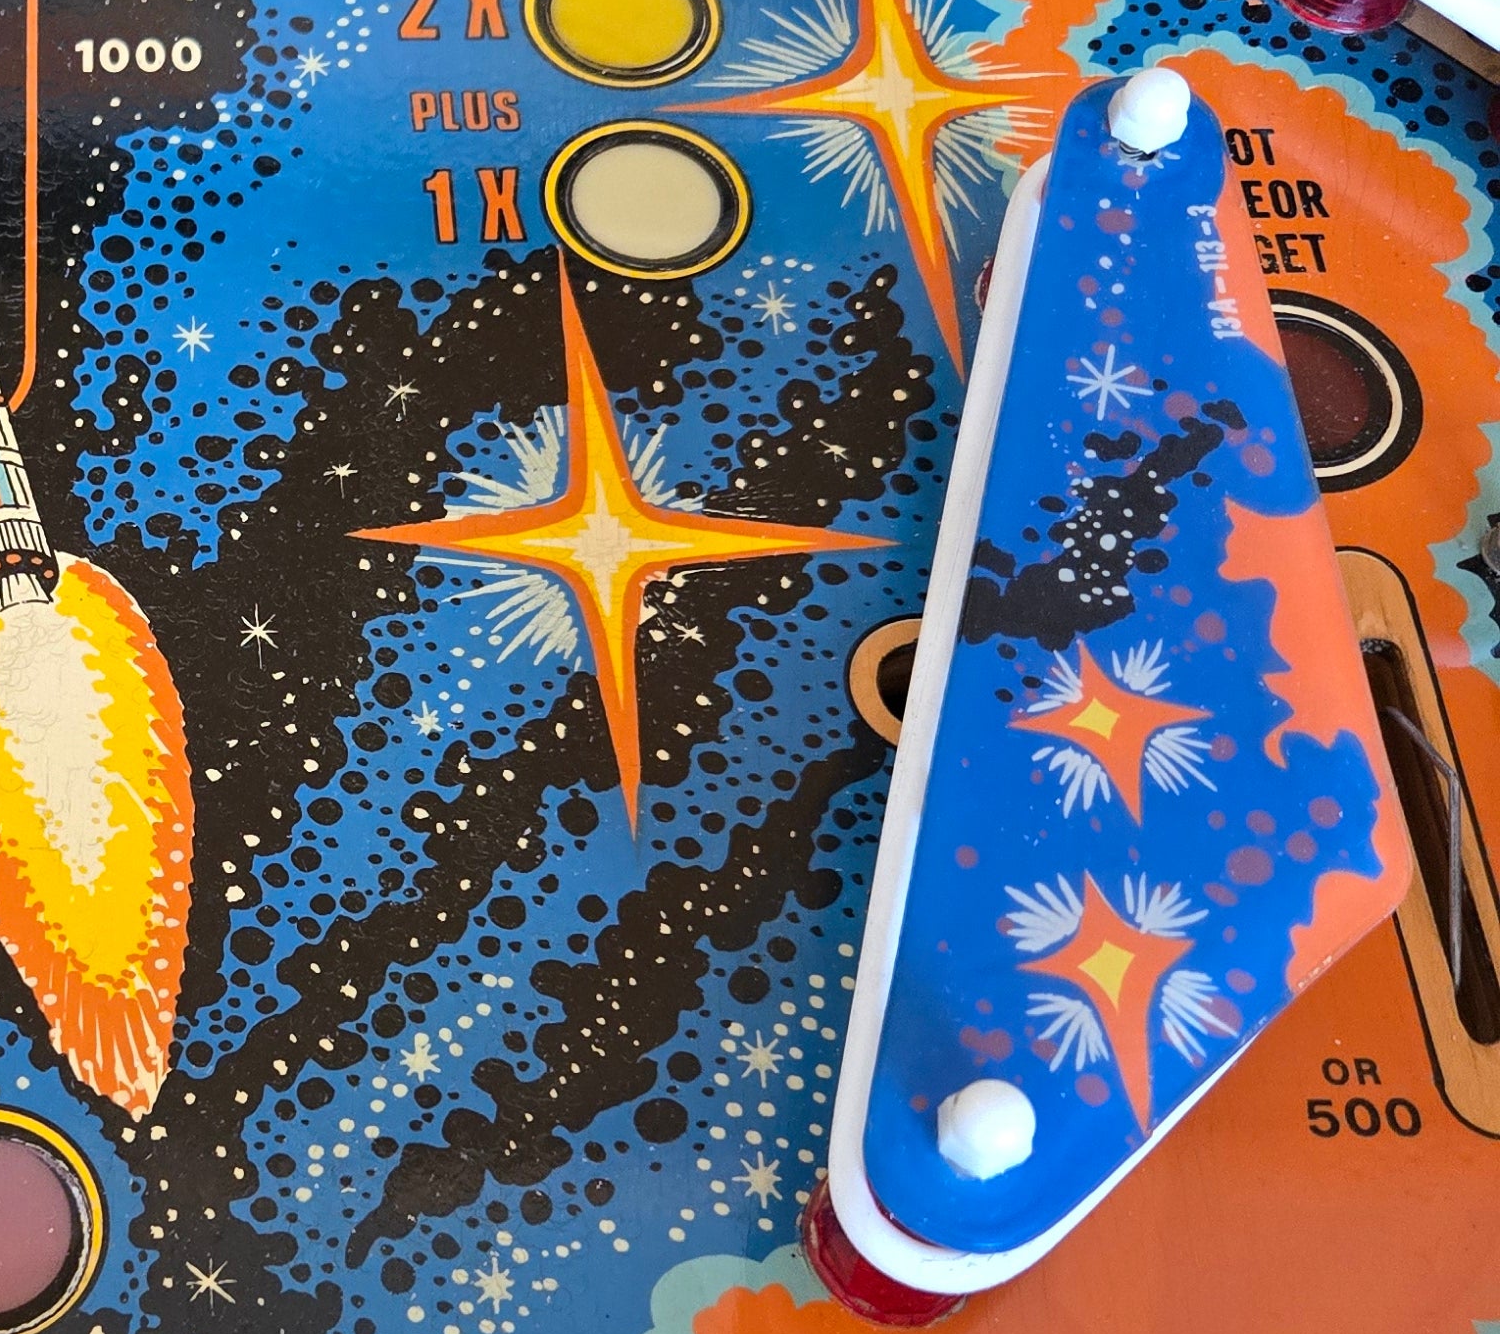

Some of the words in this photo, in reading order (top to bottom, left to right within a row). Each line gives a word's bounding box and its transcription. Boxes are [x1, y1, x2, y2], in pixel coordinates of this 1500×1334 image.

[73, 36, 203, 74] 1000
[411, 90, 520, 132] PLUS
[1225, 128, 1275, 166] OT
[423, 169, 456, 243] 1
[478, 167, 526, 242] X
[1240, 180, 1330, 218] EOR
[1186, 203, 1245, 340] 13A-113-3
[1253, 233, 1327, 275] GET
[1321, 1057, 1383, 1087] OR
[1305, 1097, 1423, 1139] 500
